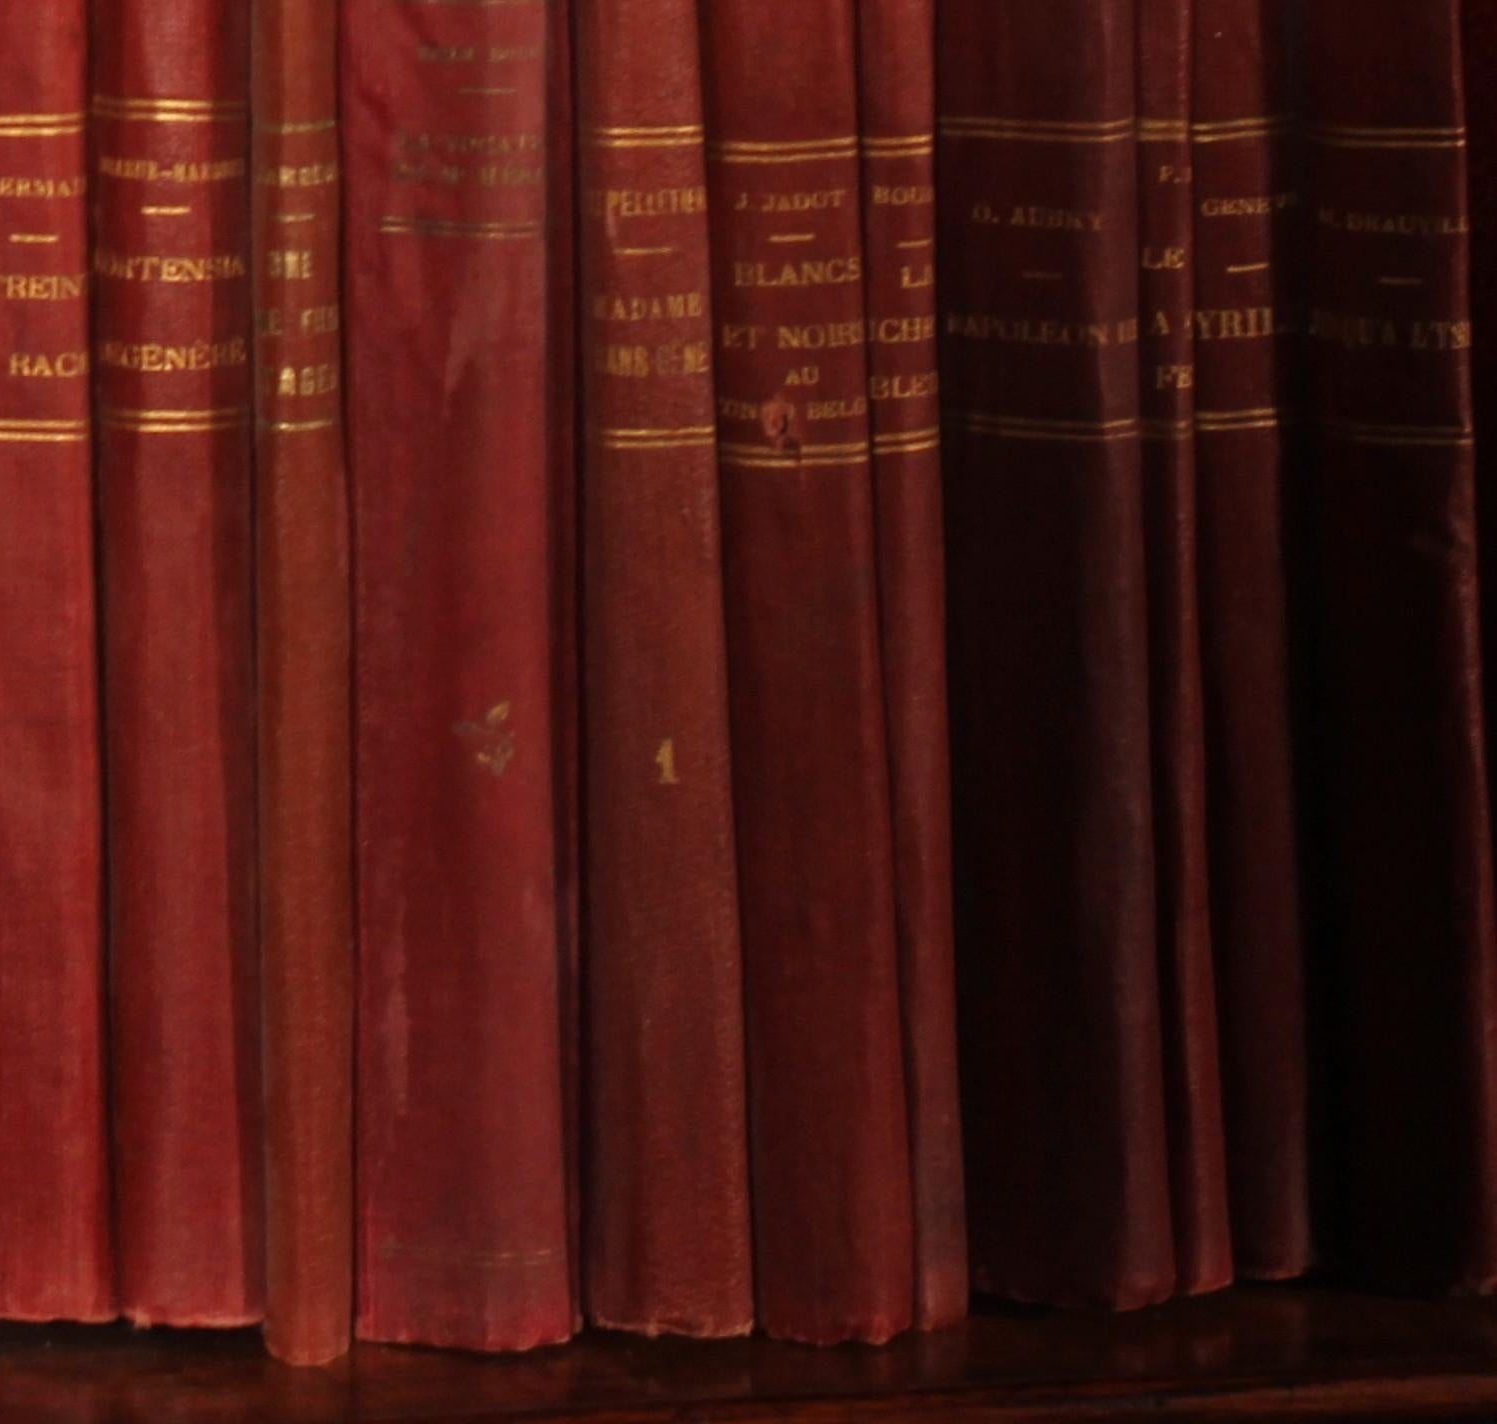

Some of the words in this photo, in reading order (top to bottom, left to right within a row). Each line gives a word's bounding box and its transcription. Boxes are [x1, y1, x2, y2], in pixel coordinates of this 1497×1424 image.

[761, 189, 846, 212] JADOT
[734, 257, 862, 288] BLANCS
[783, 366, 819, 386] AU
[654, 738, 681, 785] 1
